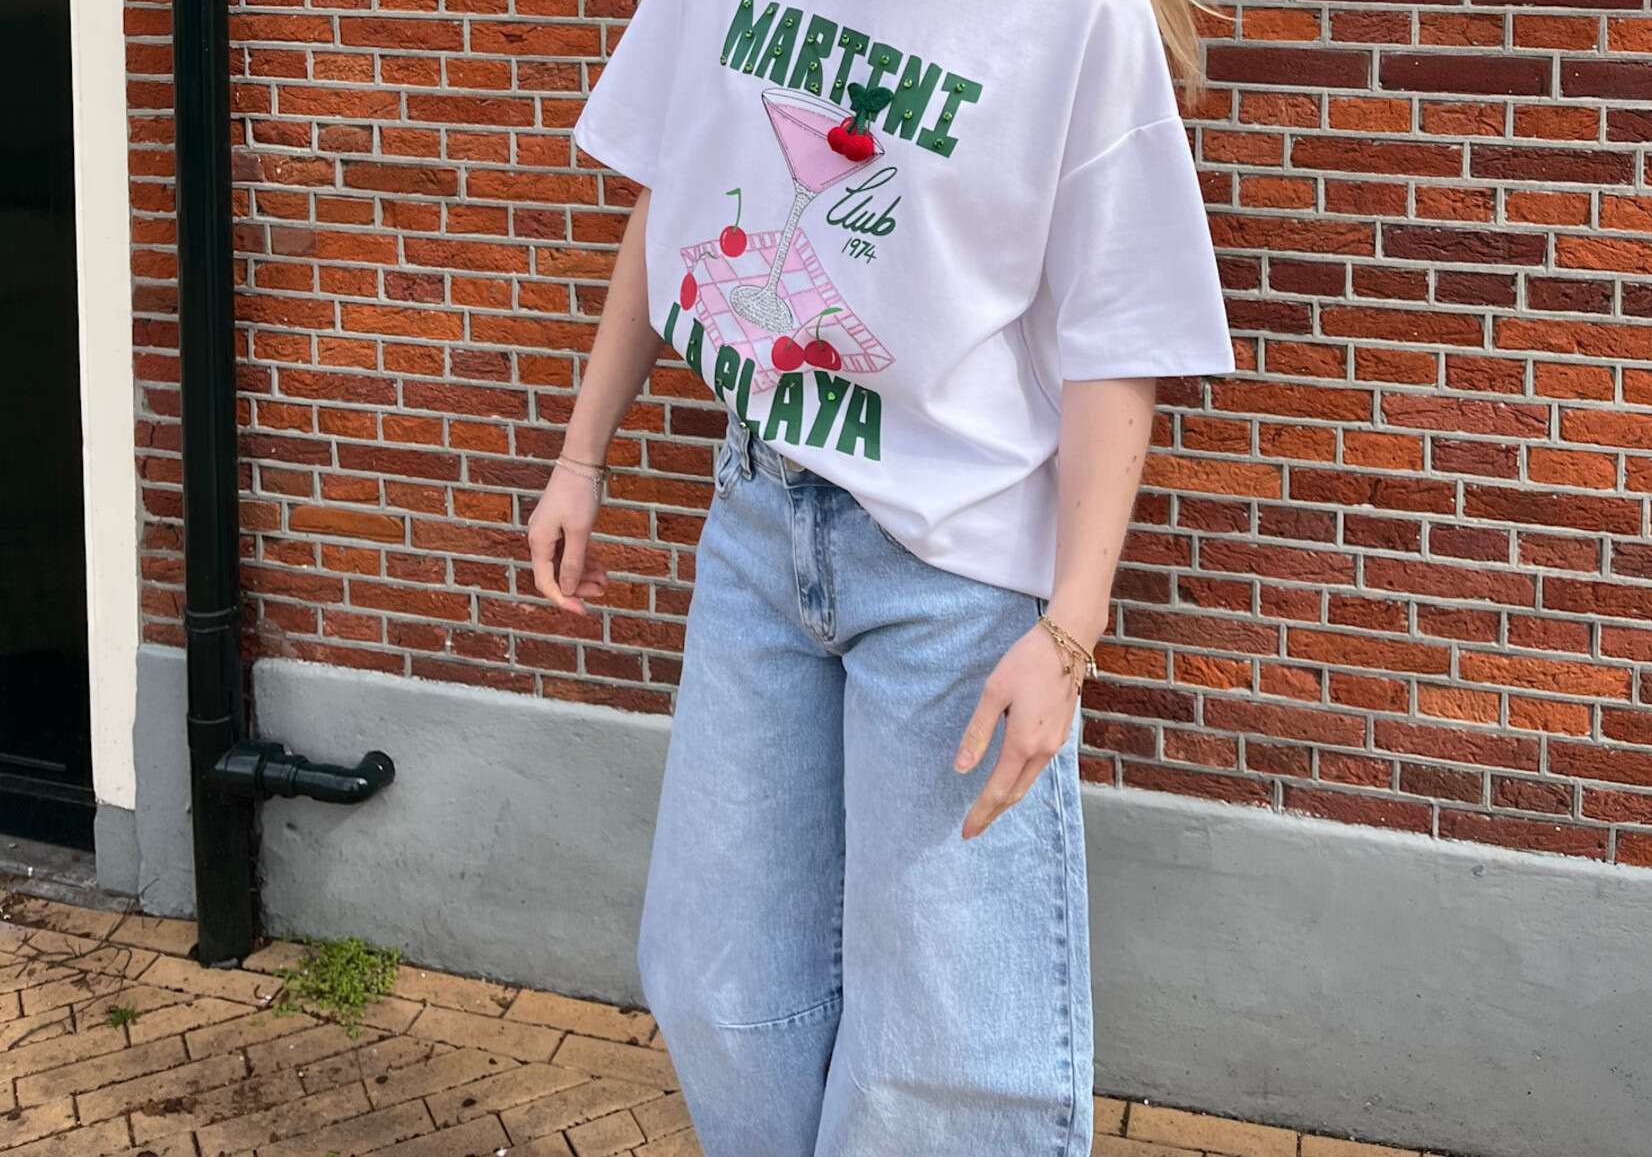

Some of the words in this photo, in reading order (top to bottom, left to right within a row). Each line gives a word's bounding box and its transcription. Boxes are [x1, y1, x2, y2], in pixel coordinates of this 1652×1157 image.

[826, 166, 901, 236] Club
[841, 237, 877, 264] 1974
[714, 344, 882, 462] PLAYA
